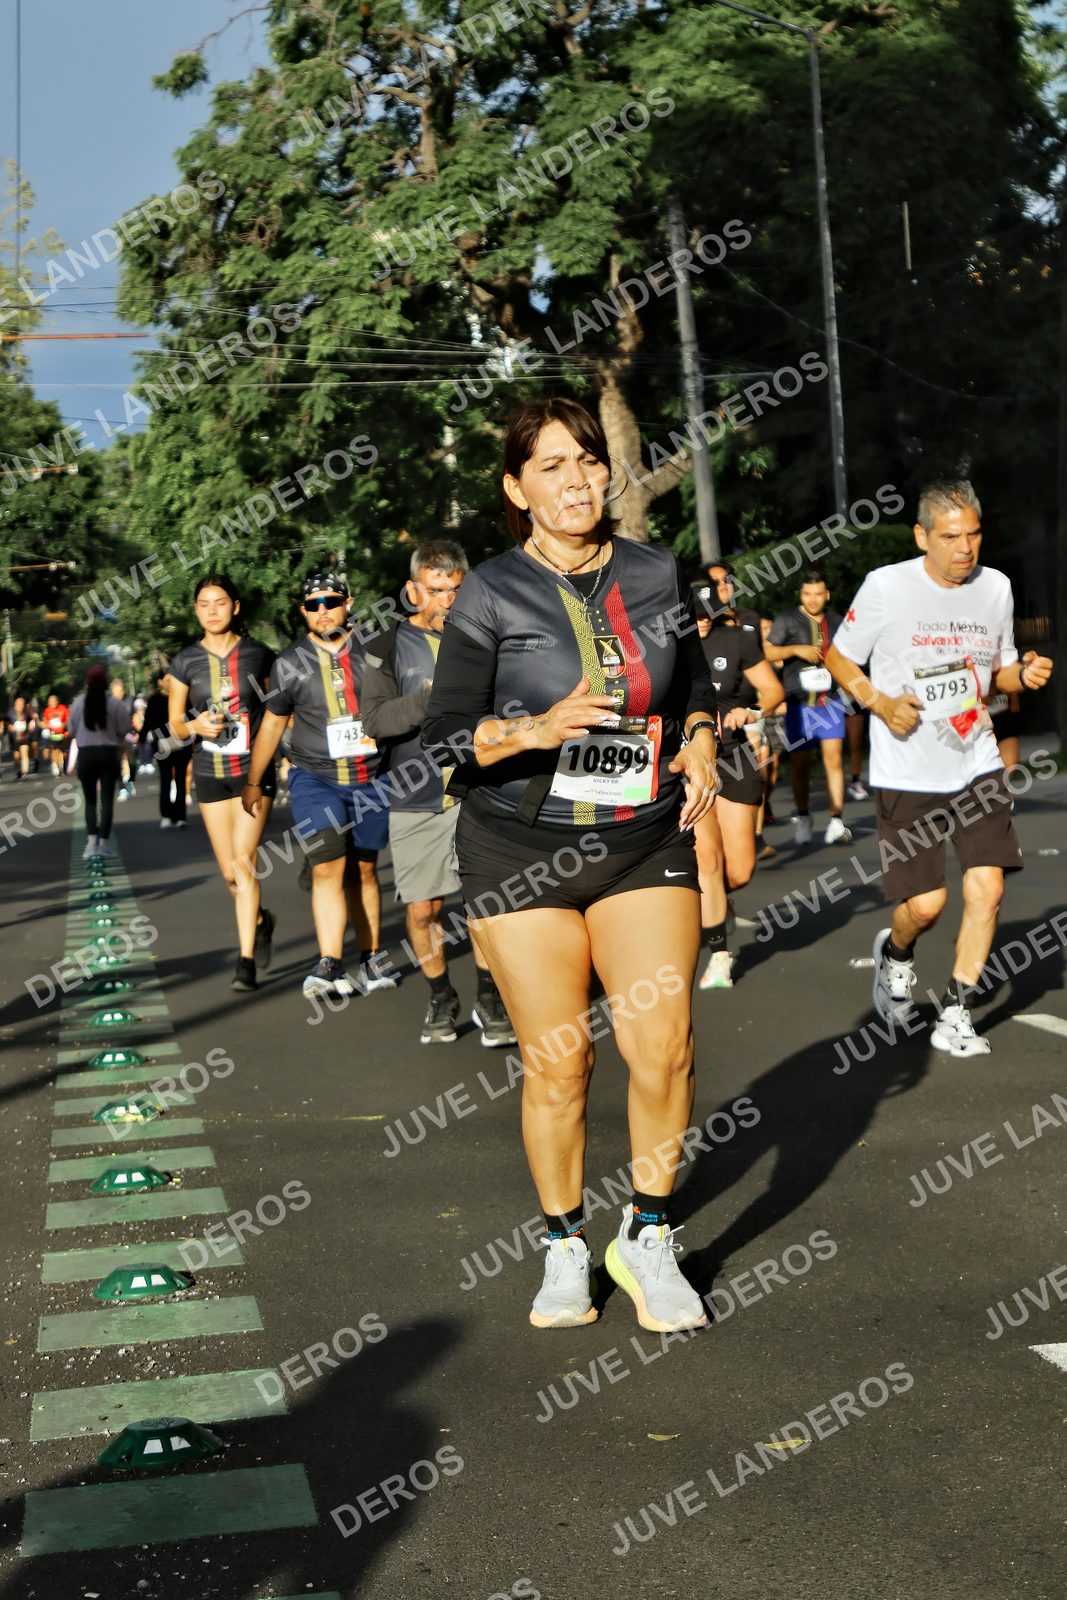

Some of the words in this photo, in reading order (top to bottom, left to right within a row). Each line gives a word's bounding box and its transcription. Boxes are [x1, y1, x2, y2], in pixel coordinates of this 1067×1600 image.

[917, 621, 947, 631] Todo
[912, 634, 963, 647] Salvando
[966, 635, 993, 649] Vidas
[925, 678, 968, 701] 8793
[568, 744, 650, 774] 10899
